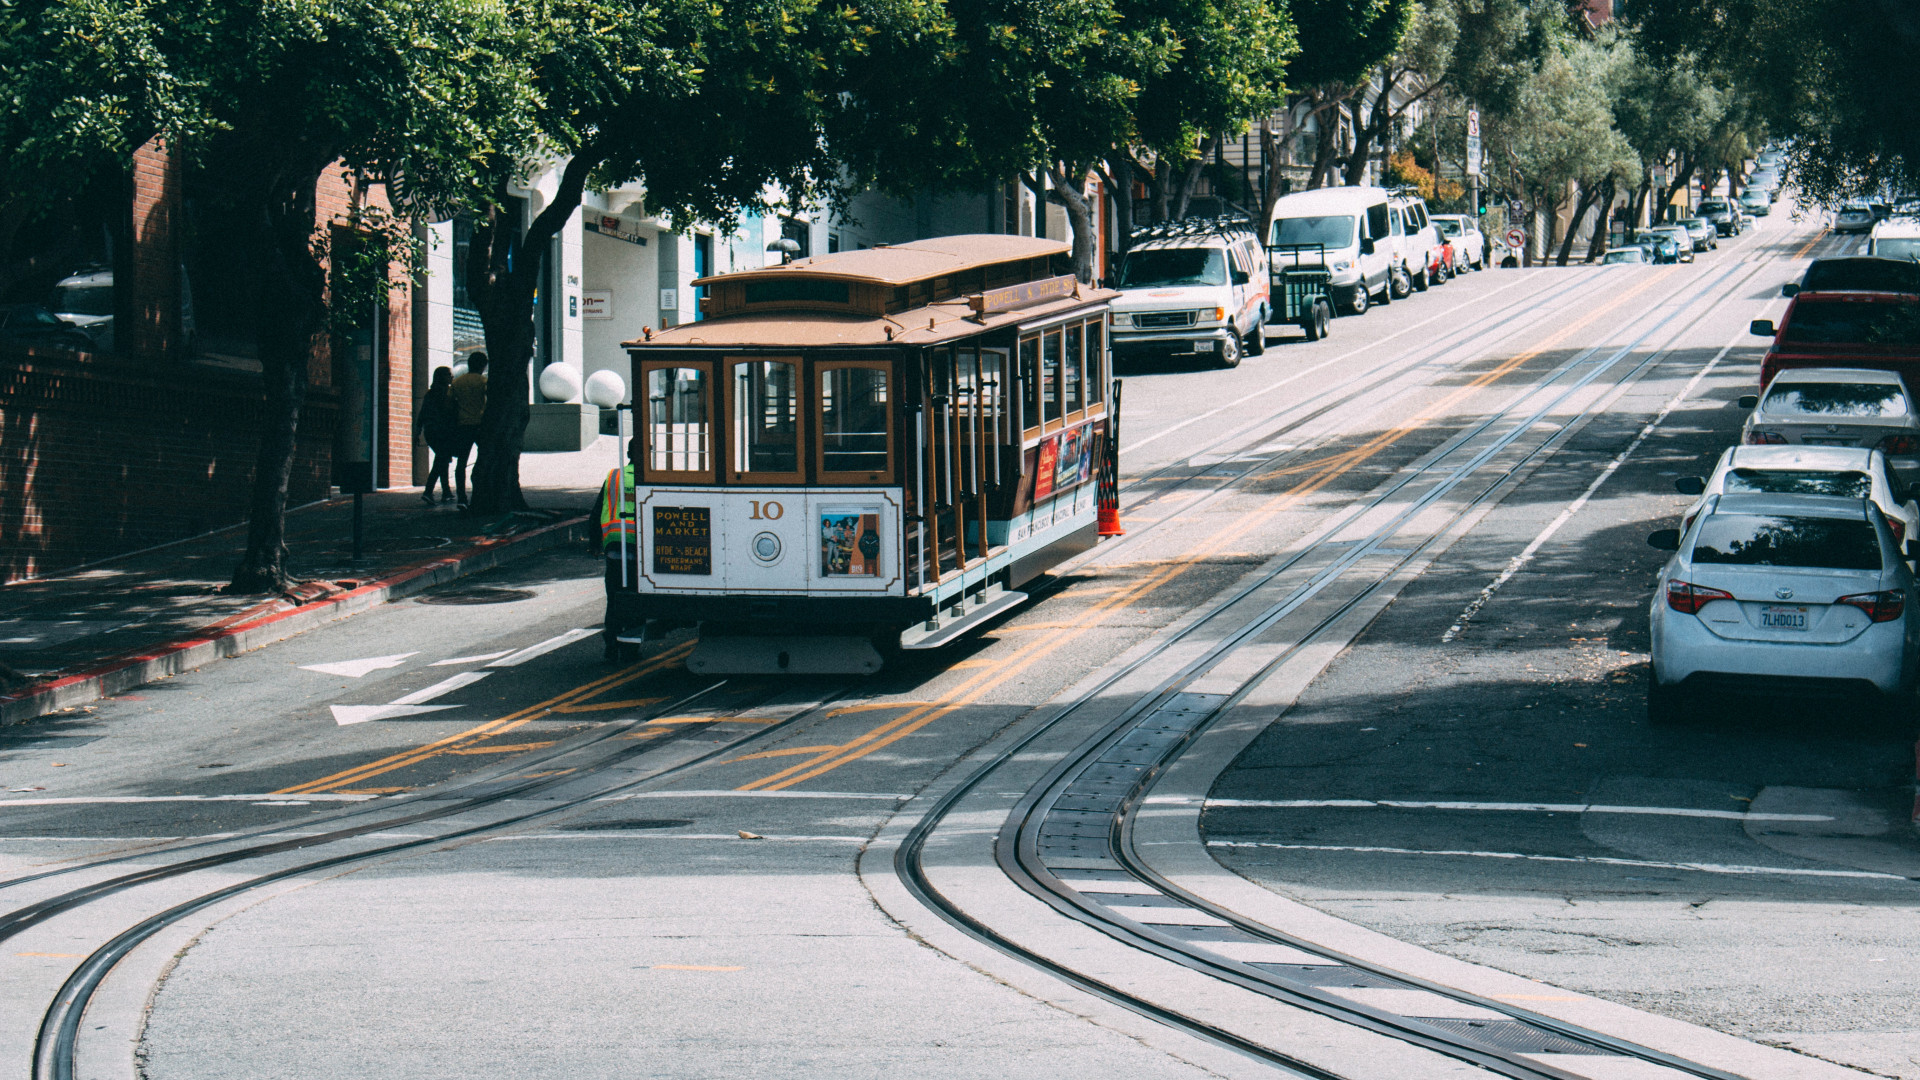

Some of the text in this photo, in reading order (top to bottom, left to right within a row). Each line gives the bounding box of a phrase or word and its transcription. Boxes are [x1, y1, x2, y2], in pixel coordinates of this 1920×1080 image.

[987, 289, 1020, 308] POWELL
[1040, 281, 1060, 296] HYDE
[749, 501, 784, 520] 10
[656, 512, 707, 521] POWELL
[655, 527, 708, 536] MARKET
[656, 545, 674, 556] HYDE
[684, 546, 708, 557] BEACH
[660, 556, 703, 565] FISHERMANS
[670, 564, 692, 572] WHARF
[1762, 614, 1804, 626] 7LHD013
